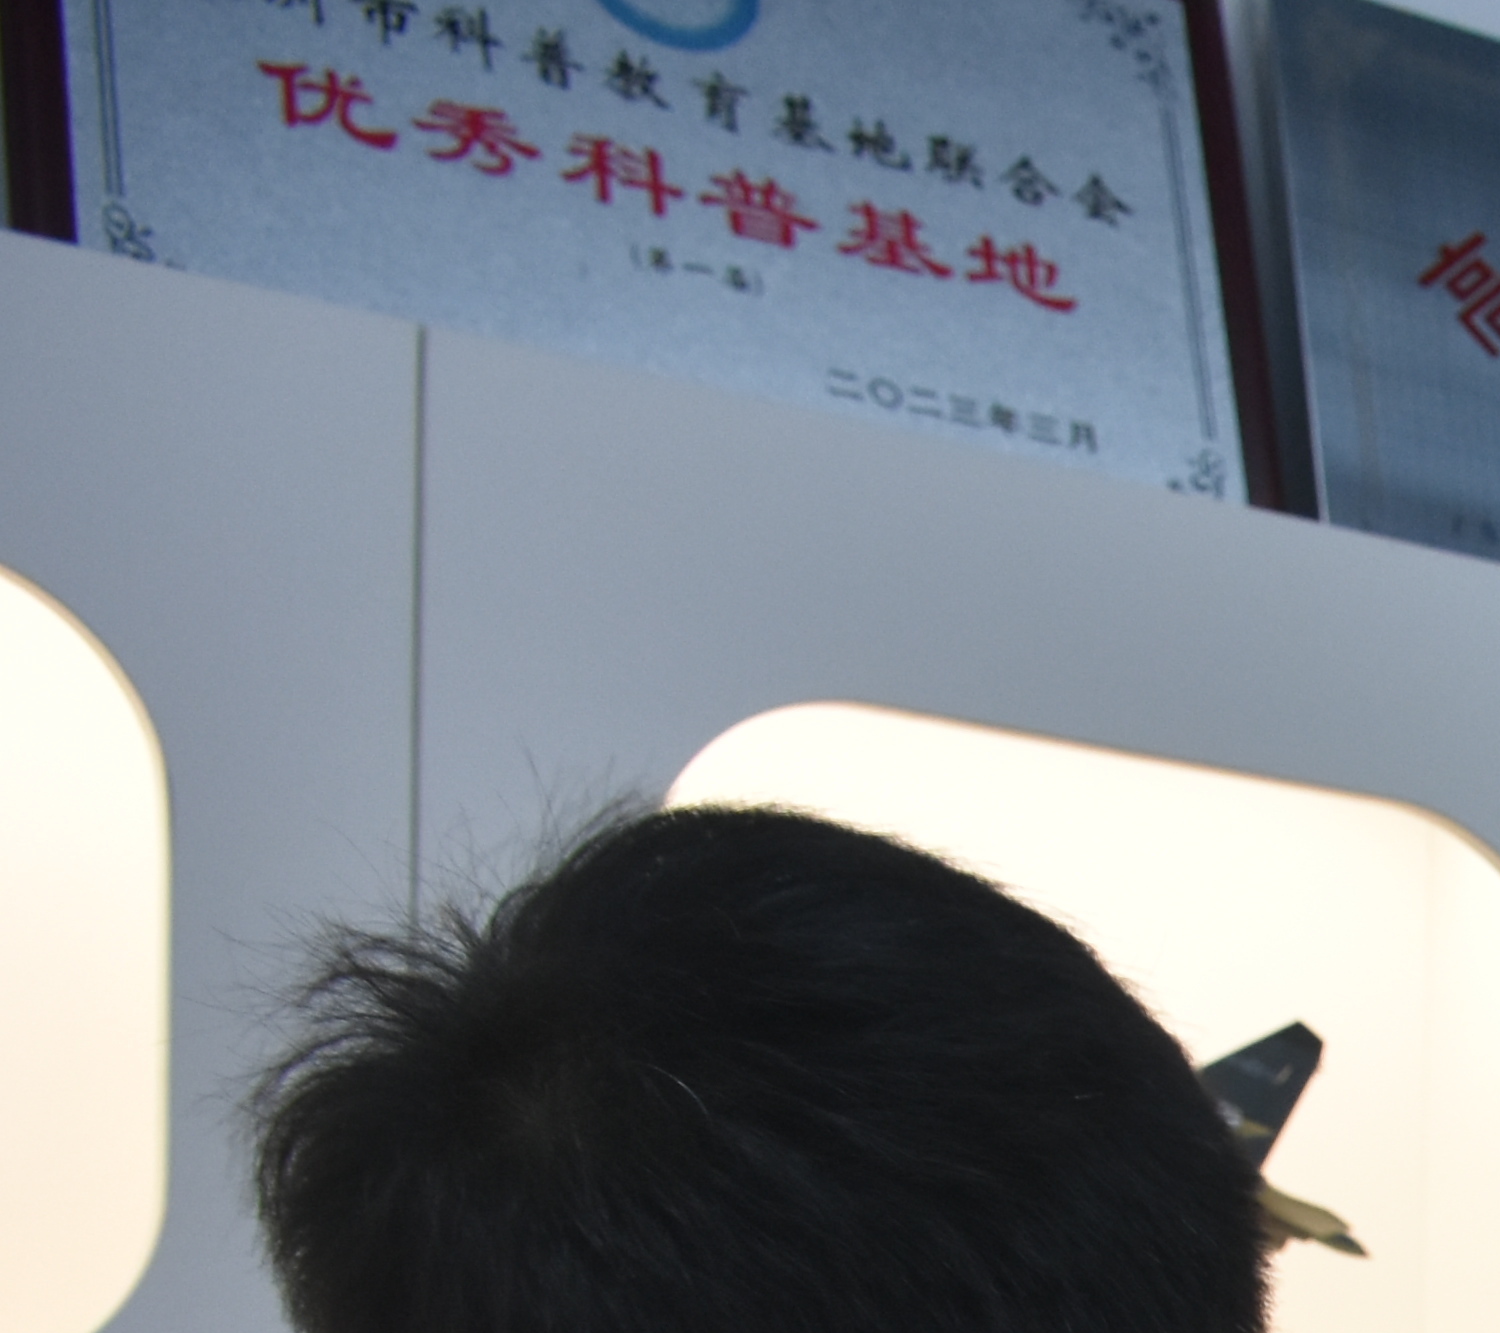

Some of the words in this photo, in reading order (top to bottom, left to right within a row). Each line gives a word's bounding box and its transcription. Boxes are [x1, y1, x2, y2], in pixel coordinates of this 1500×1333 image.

[258, 61, 1077, 313] 优秀科普基地
[262, 0, 1134, 227] 市科普教育基地联合会
